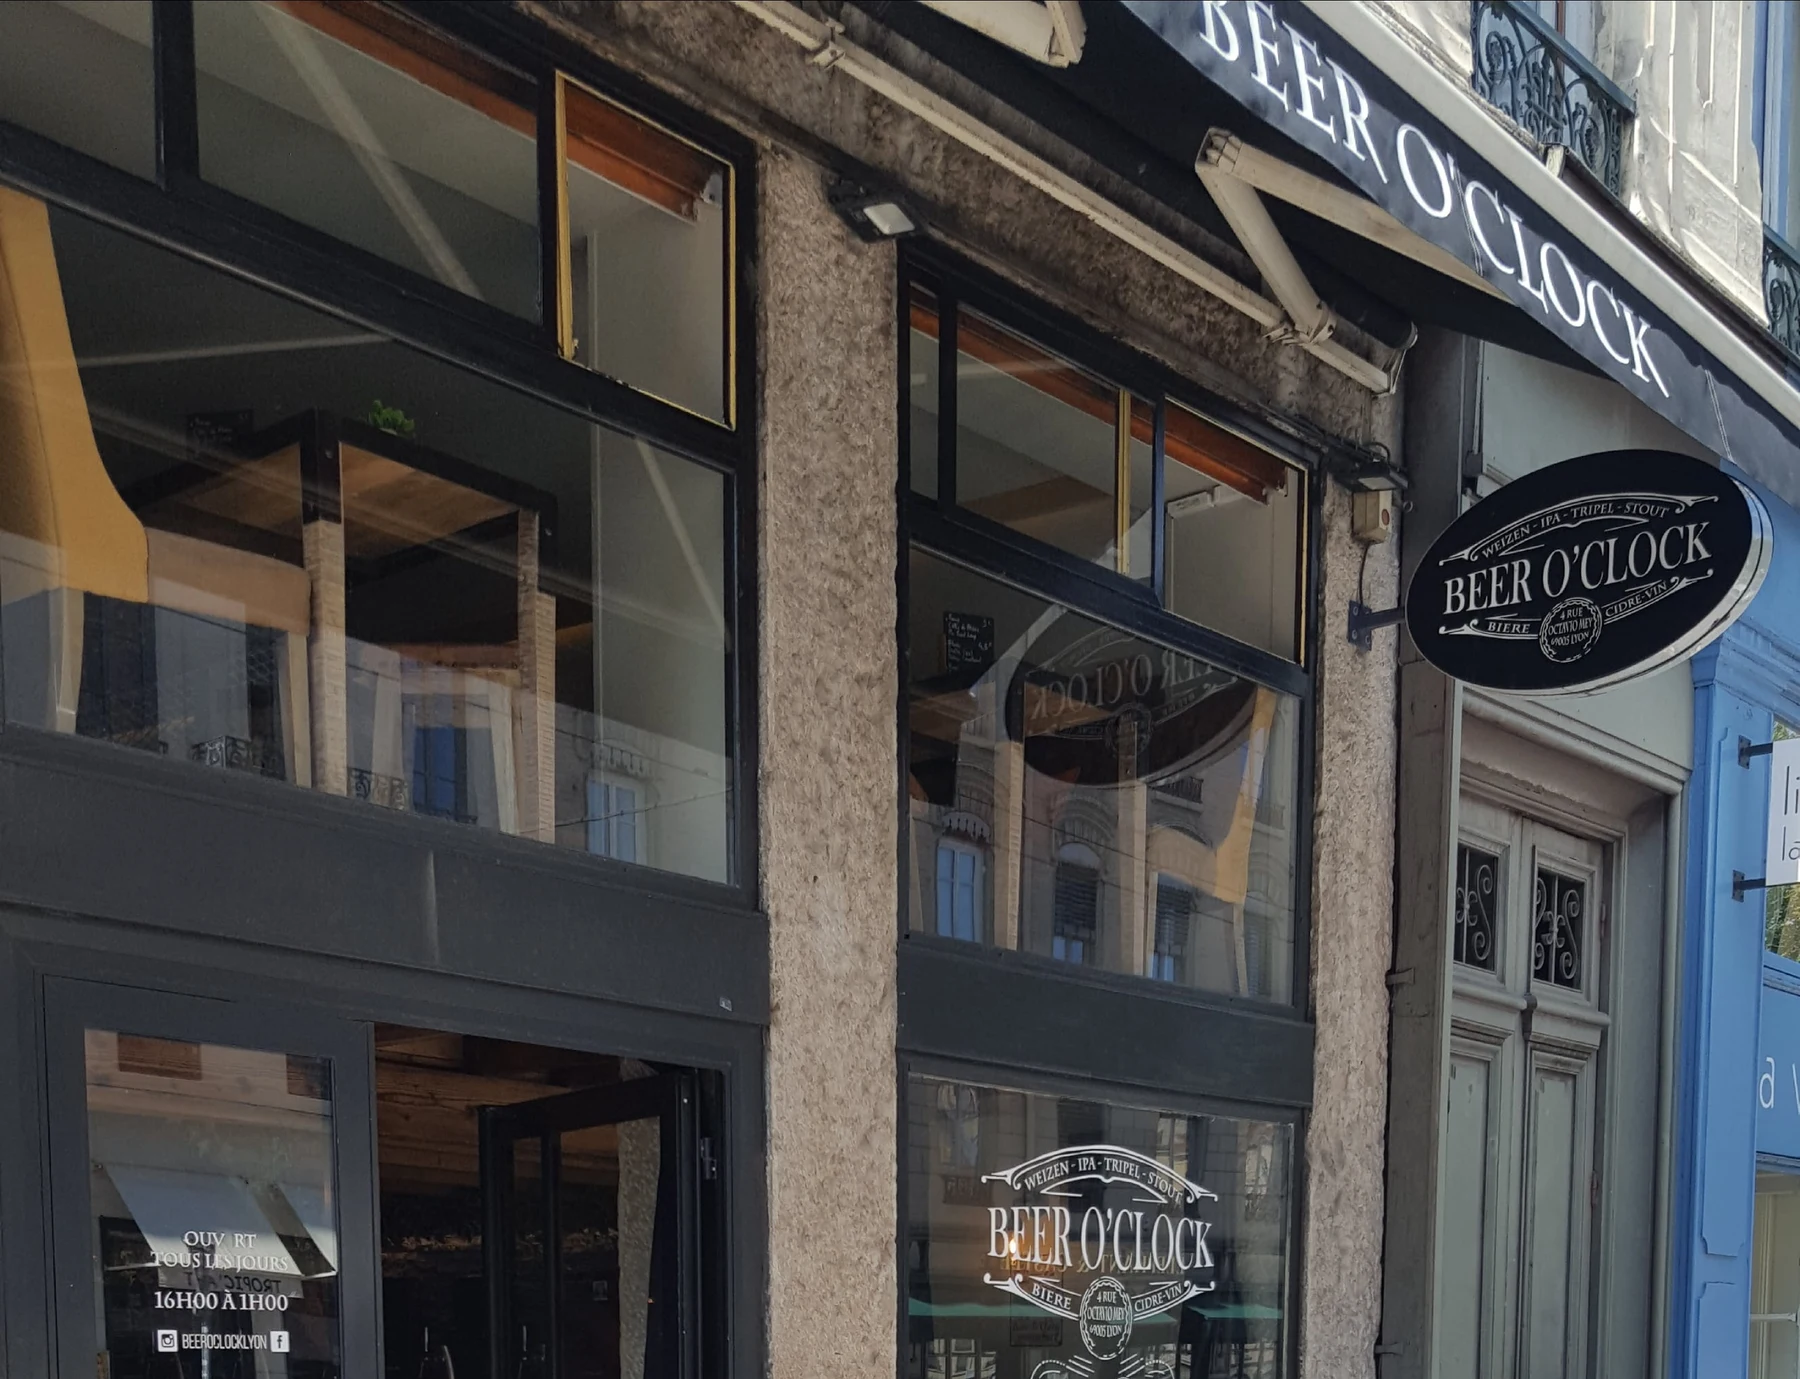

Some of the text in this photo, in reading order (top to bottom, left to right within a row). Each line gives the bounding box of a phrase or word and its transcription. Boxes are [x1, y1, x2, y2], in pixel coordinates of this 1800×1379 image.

[1396, 123, 1670, 398] O'CLOCK
[1482, 524, 1531, 558] WEIZEN
[1541, 513, 1561, 529] IPA
[1570, 503, 1614, 519] TRIPEL
[1624, 502, 1669, 518] STOUT
[1443, 522, 1711, 615] BEER O'CLOCK
[1604, 581, 1668, 619] CIDRE-VIN
[1567, 607, 1583, 618] RUE
[1487, 621, 1530, 634] BIERE
[1571, 631, 1589, 644] LYON
[1024, 1161, 1069, 1191] WEIZEN
[1078, 1157, 1096, 1172] IPA
[1104, 1157, 1141, 1179] TRIPEL
[1147, 1171, 1184, 1203] STOUT
[183, 1230, 257, 1248] OUVRT
[987, 1206, 1214, 1271] BEER O'CLOCK
[151, 1251, 201, 1268] TOUS
[236, 1255, 289, 1273] JOURS
[154, 1289, 288, 1311] 16H00 À 1H00
[1031, 1284, 1072, 1311] BIERE
[1103, 1291, 1117, 1304] RUE
[1134, 1281, 1182, 1313] CIDRE-VIN
[182, 1333, 267, 1350] BEEROCLOCKLYON
